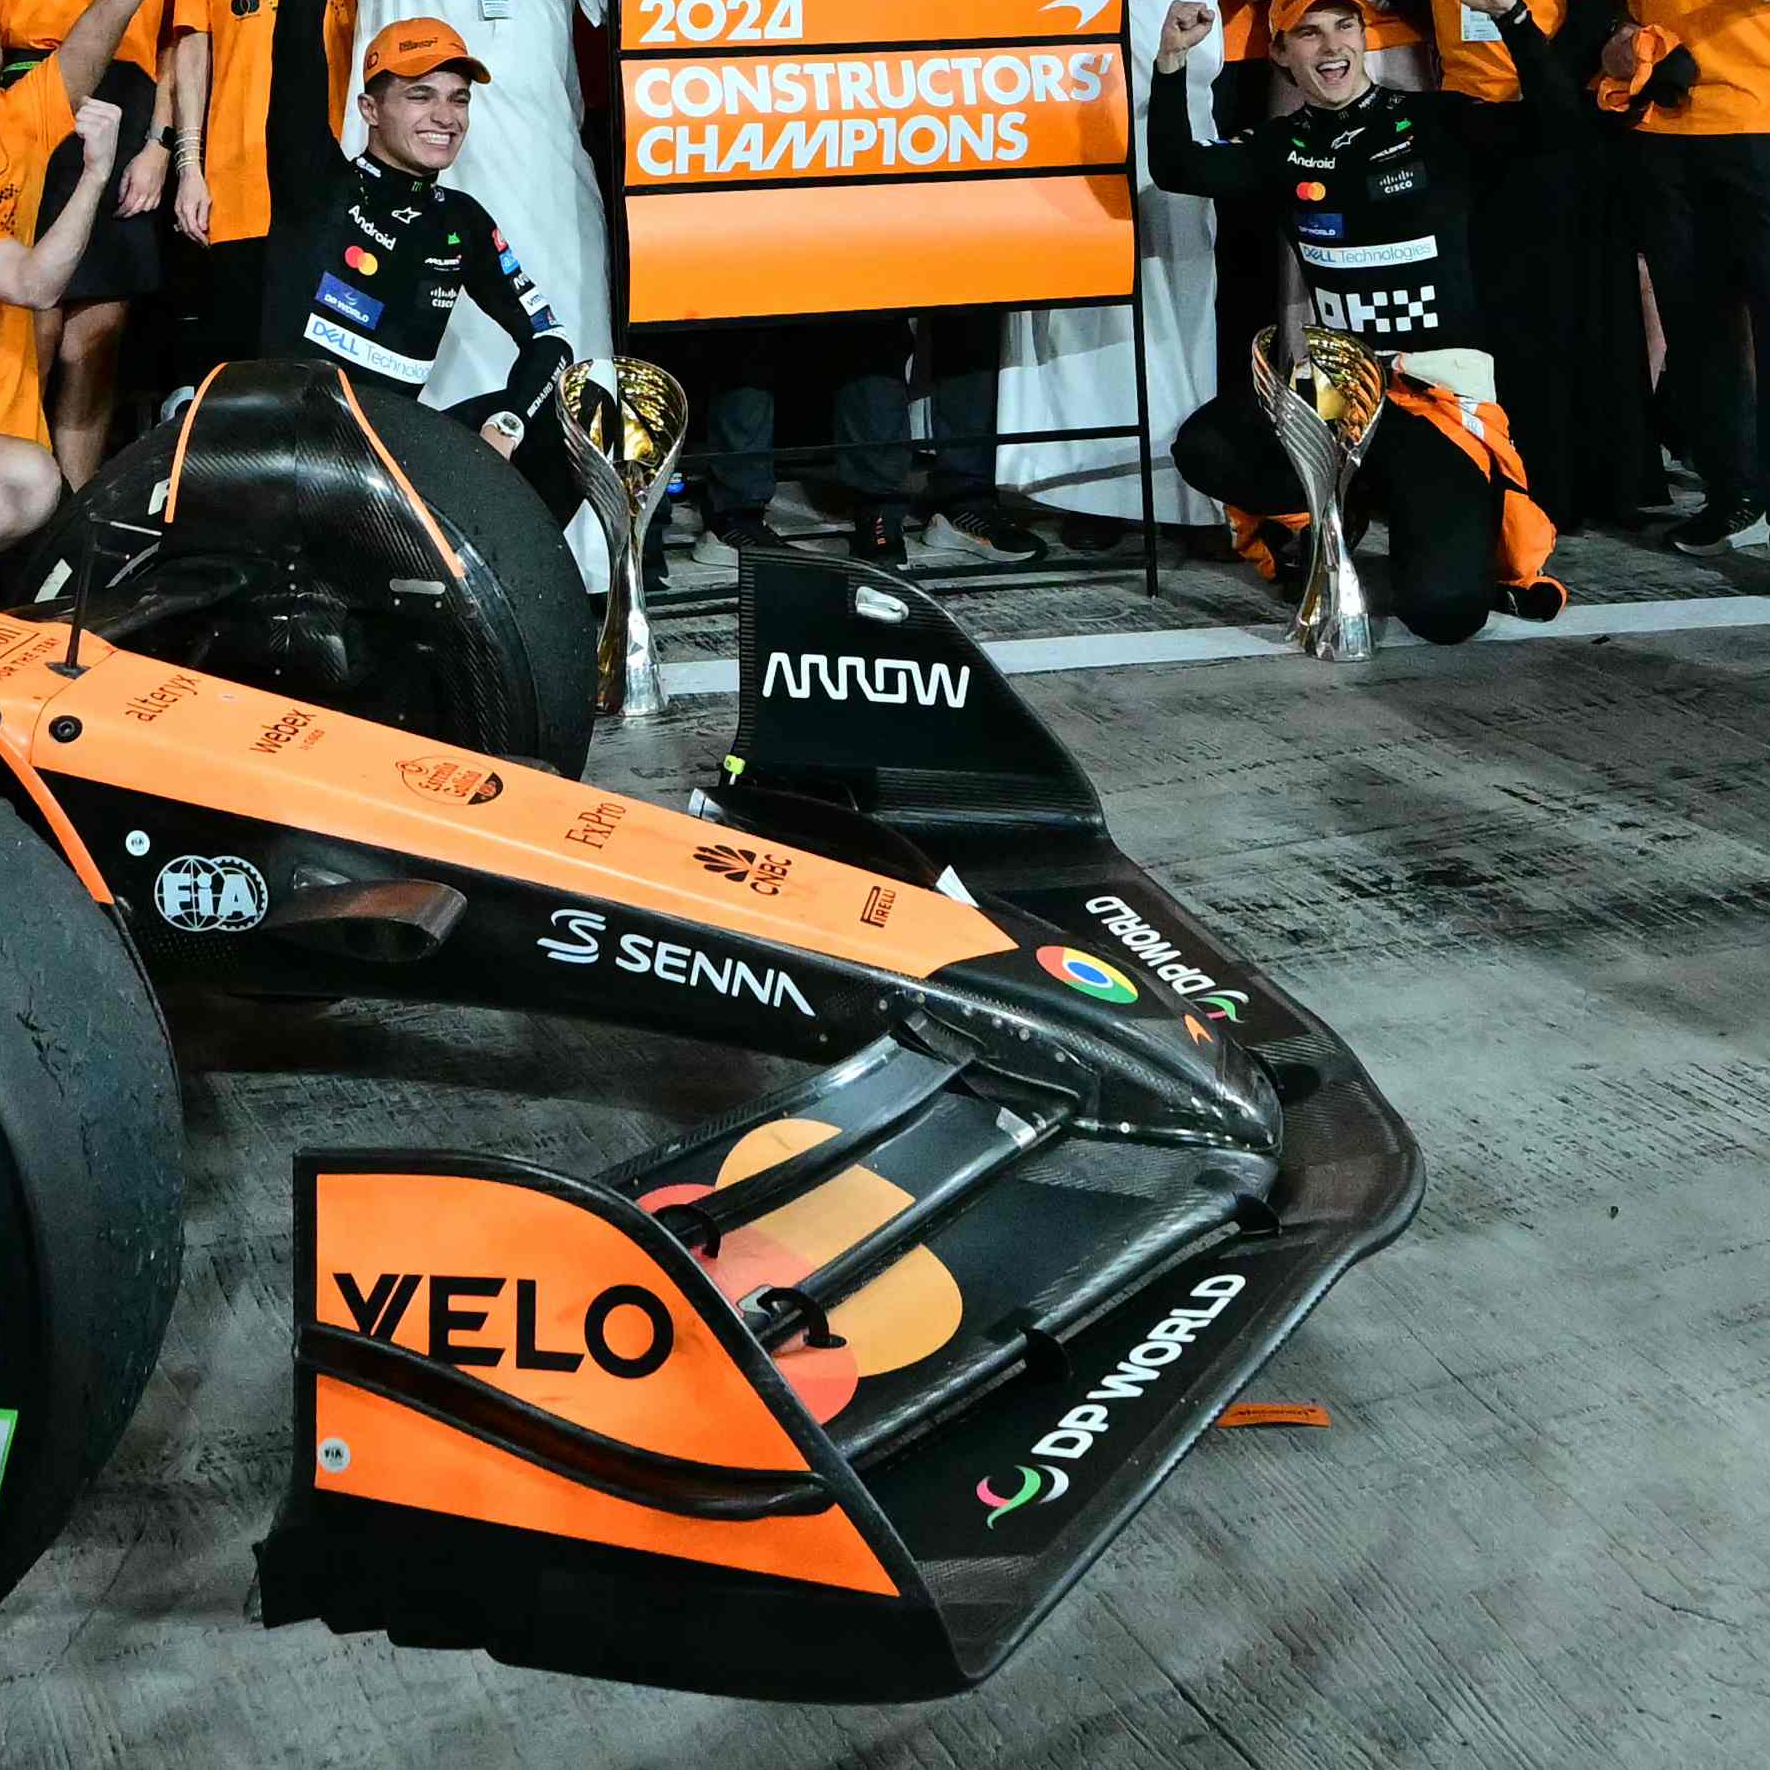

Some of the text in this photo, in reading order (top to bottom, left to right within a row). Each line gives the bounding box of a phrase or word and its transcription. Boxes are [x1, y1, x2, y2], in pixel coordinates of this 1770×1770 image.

[634, 52, 1114, 118] CONSTRUCTORS'
[635, 112, 1029, 176] CHAMPIONS
[1288, 149, 1338, 170] Android
[1383, 179, 1414, 195] CISCO
[347, 204, 397, 252] Android
[1315, 285, 1439, 333] OKX
[312, 321, 361, 356] DELL
[125, 672, 204, 724] alteryx
[762, 652, 971, 709] ARROW
[249, 708, 319, 755] webex
[565, 801, 628, 851] FxPro
[749, 853, 793, 896] CNBC
[859, 885, 897, 928] PIRELLI
[1084, 895, 1218, 996] DP WORLD
[615, 932, 817, 1017] SENNA
[332, 1272, 674, 1381] VELO
[1030, 1273, 1248, 1460] DP WORLD
